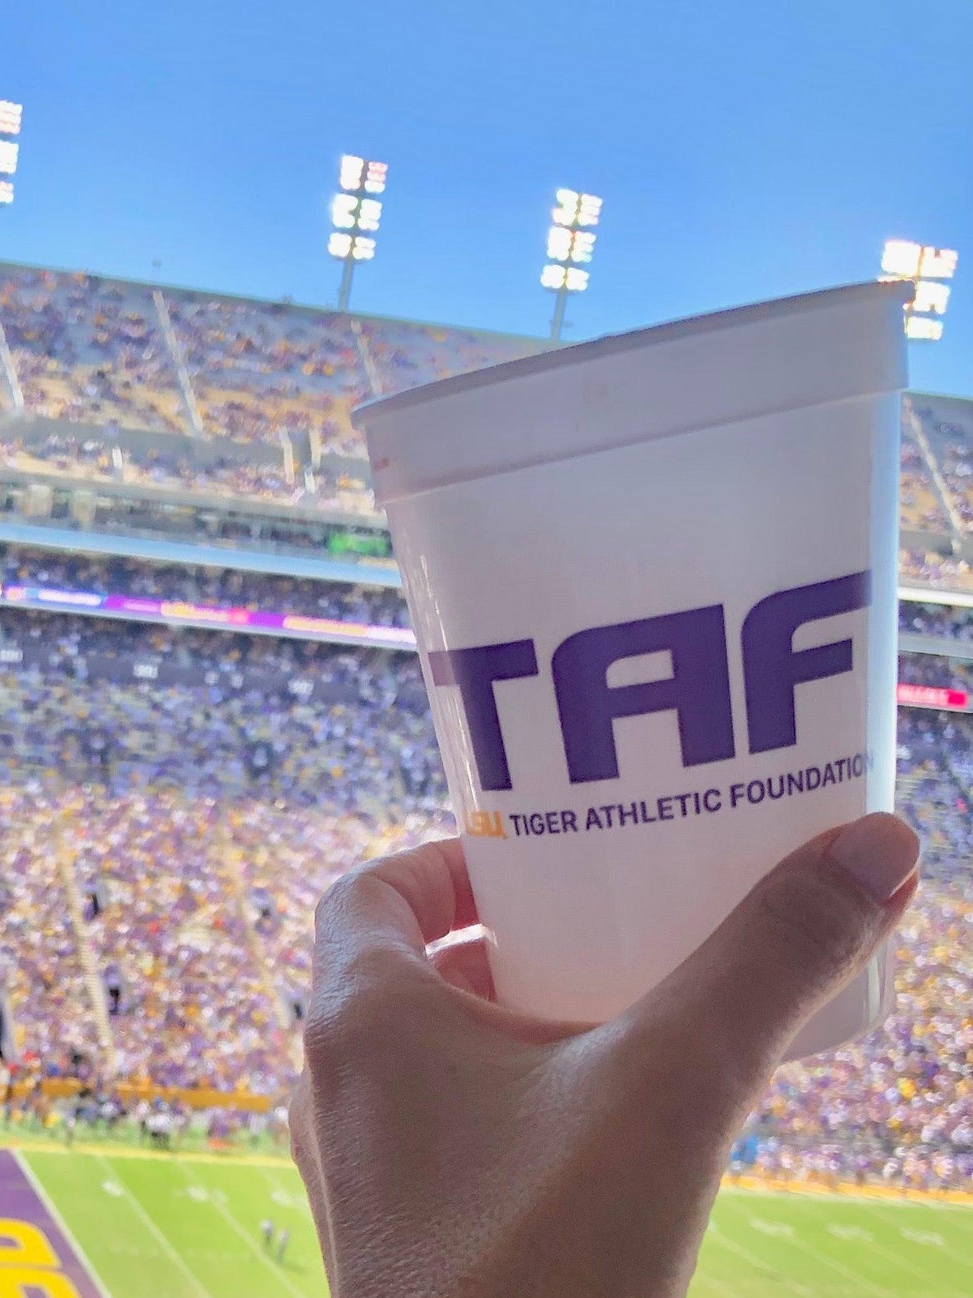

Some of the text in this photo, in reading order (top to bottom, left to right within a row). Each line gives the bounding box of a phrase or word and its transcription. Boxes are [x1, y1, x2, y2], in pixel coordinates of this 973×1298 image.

[427, 570, 872, 791] TAF
[510, 810, 578, 836] TIGER
[585, 788, 722, 831] ATHLETIC
